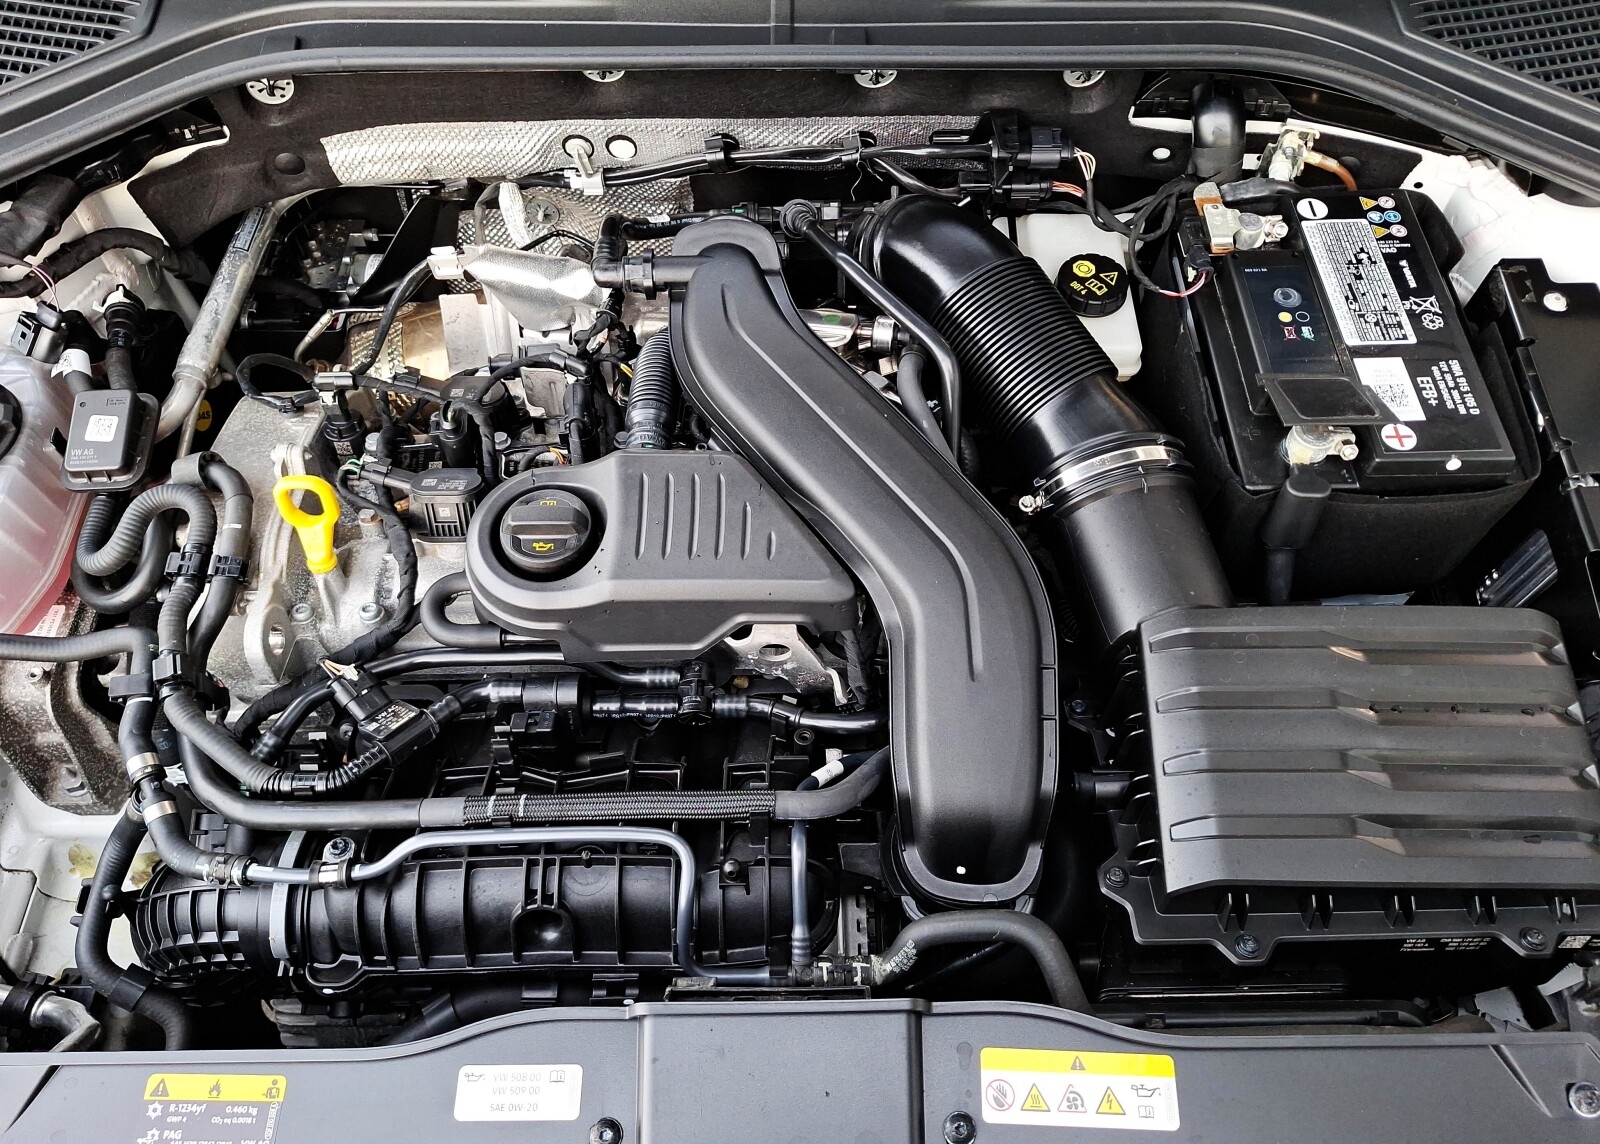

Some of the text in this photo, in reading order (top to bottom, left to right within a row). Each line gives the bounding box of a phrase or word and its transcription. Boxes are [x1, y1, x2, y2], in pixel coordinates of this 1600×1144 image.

[1070, 281, 1084, 291] DOT
[1438, 360, 1450, 372] 12V
[1416, 376, 1439, 407] EFB+
[1448, 359, 1480, 415] 5WA 915 105 D
[71, 448, 83, 456] VW
[374, 704, 399, 720] VW AG
[493, 1073, 542, 1081] VW 508 00
[492, 1086, 541, 1095] VW 509 00
[169, 1103, 258, 1116] R-1234yf 0.460 kg
[490, 1103, 538, 1112] SAE 0W-20
[166, 1115, 182, 1123] GWP
[182, 1115, 187, 1123] 4
[223, 1117, 231, 1125] eq
[163, 1129, 182, 1140] PAG
